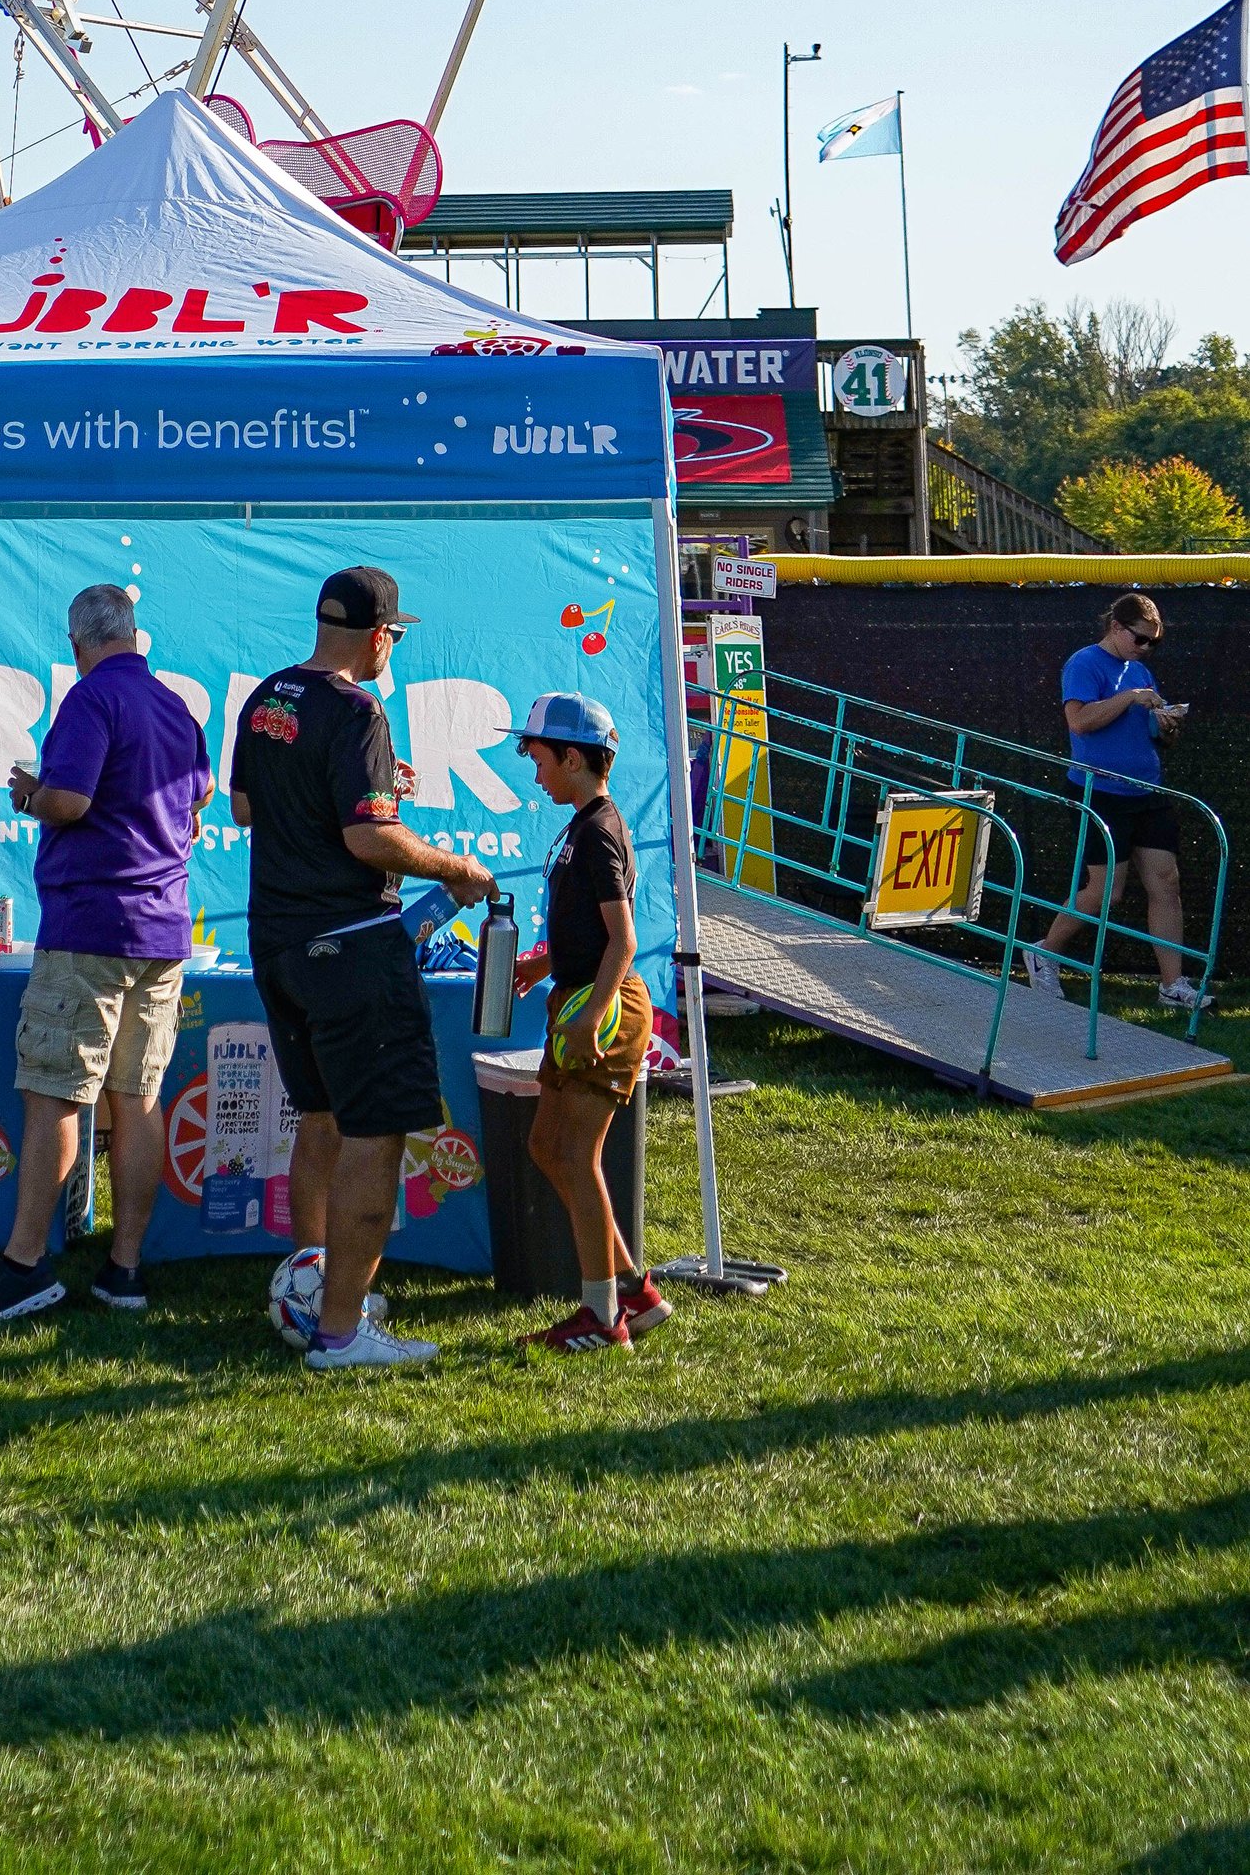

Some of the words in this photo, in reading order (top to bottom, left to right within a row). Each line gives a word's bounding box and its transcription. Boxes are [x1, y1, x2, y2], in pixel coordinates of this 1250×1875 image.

[664, 350, 785, 384] WATER
[841, 363, 892, 406] 41
[43, 409, 139, 450] with
[717, 561, 733, 573] NO
[736, 564, 773, 578] SINGLE
[725, 577, 763, 590] RIDERS
[724, 651, 754, 674] YES
[893, 827, 965, 890] EXIT
